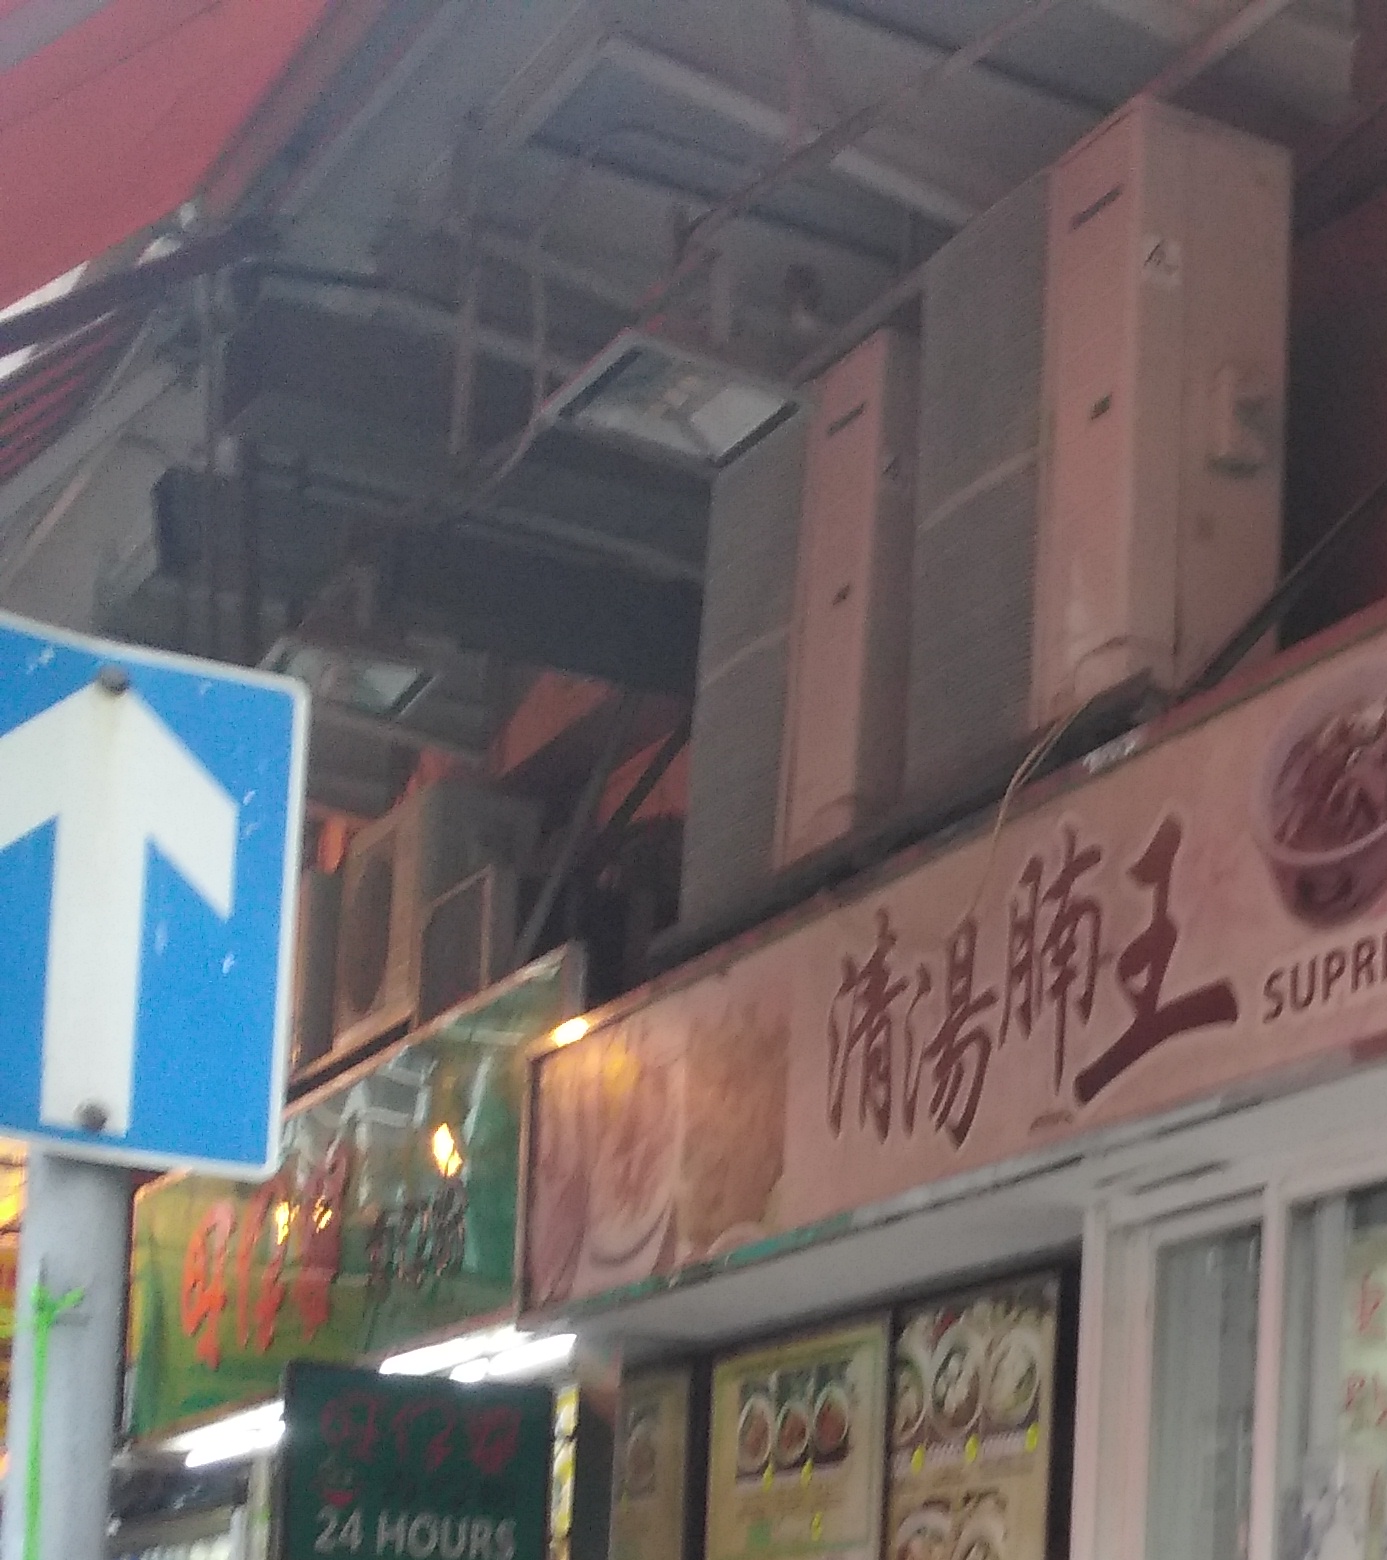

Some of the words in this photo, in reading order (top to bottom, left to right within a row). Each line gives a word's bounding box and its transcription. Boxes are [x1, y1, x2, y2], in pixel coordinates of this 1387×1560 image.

[827, 812, 1239, 1151] 清湯腩王
[314, 1503, 365, 1554] 24
